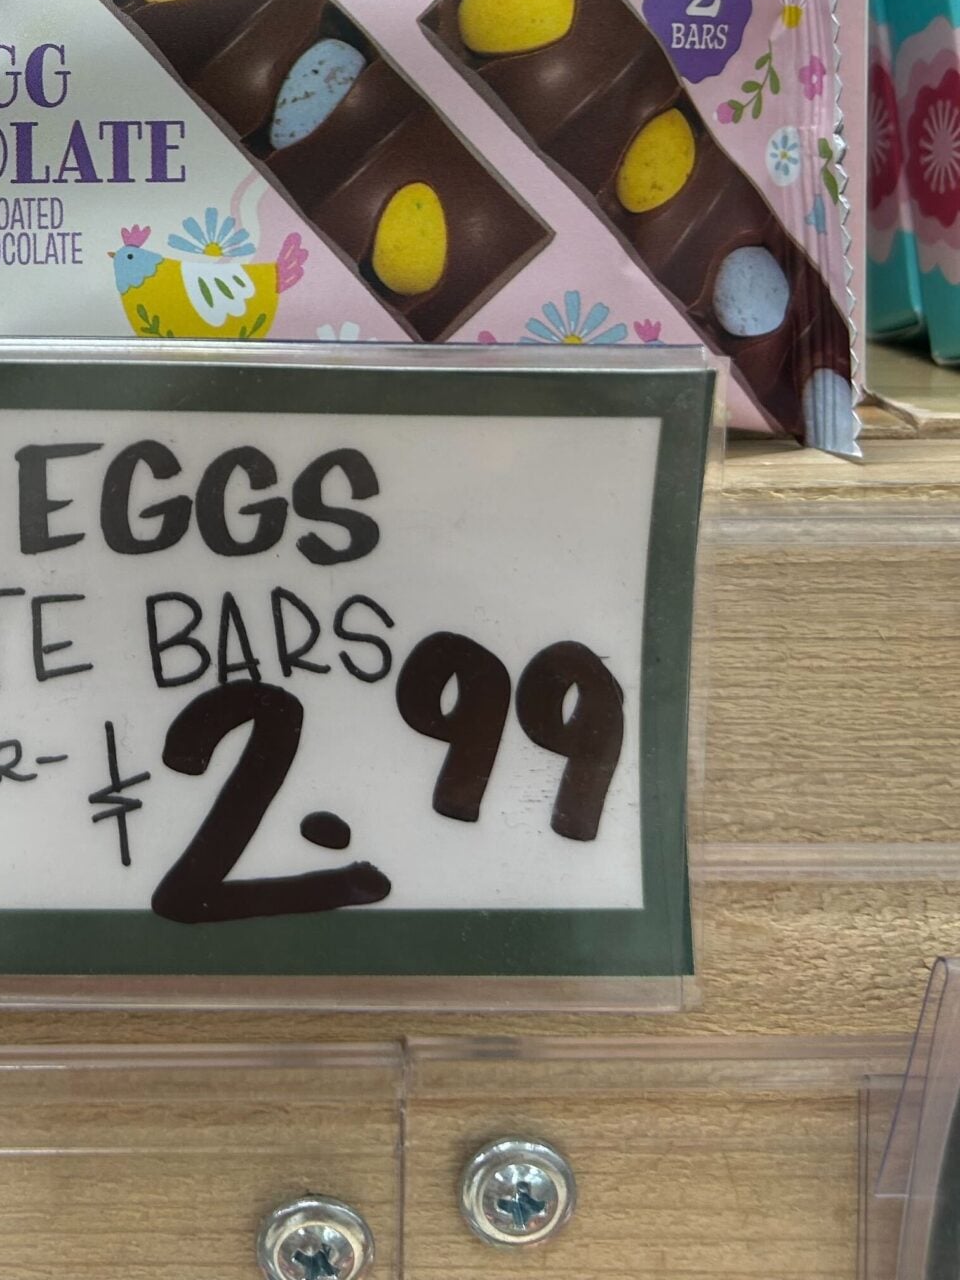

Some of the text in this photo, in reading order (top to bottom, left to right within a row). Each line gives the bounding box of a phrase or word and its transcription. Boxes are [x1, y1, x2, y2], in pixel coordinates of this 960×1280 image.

[671, 23, 729, 50] BARS
[15, 438, 381, 566] EGGS
[146, 587, 396, 688] BARS
